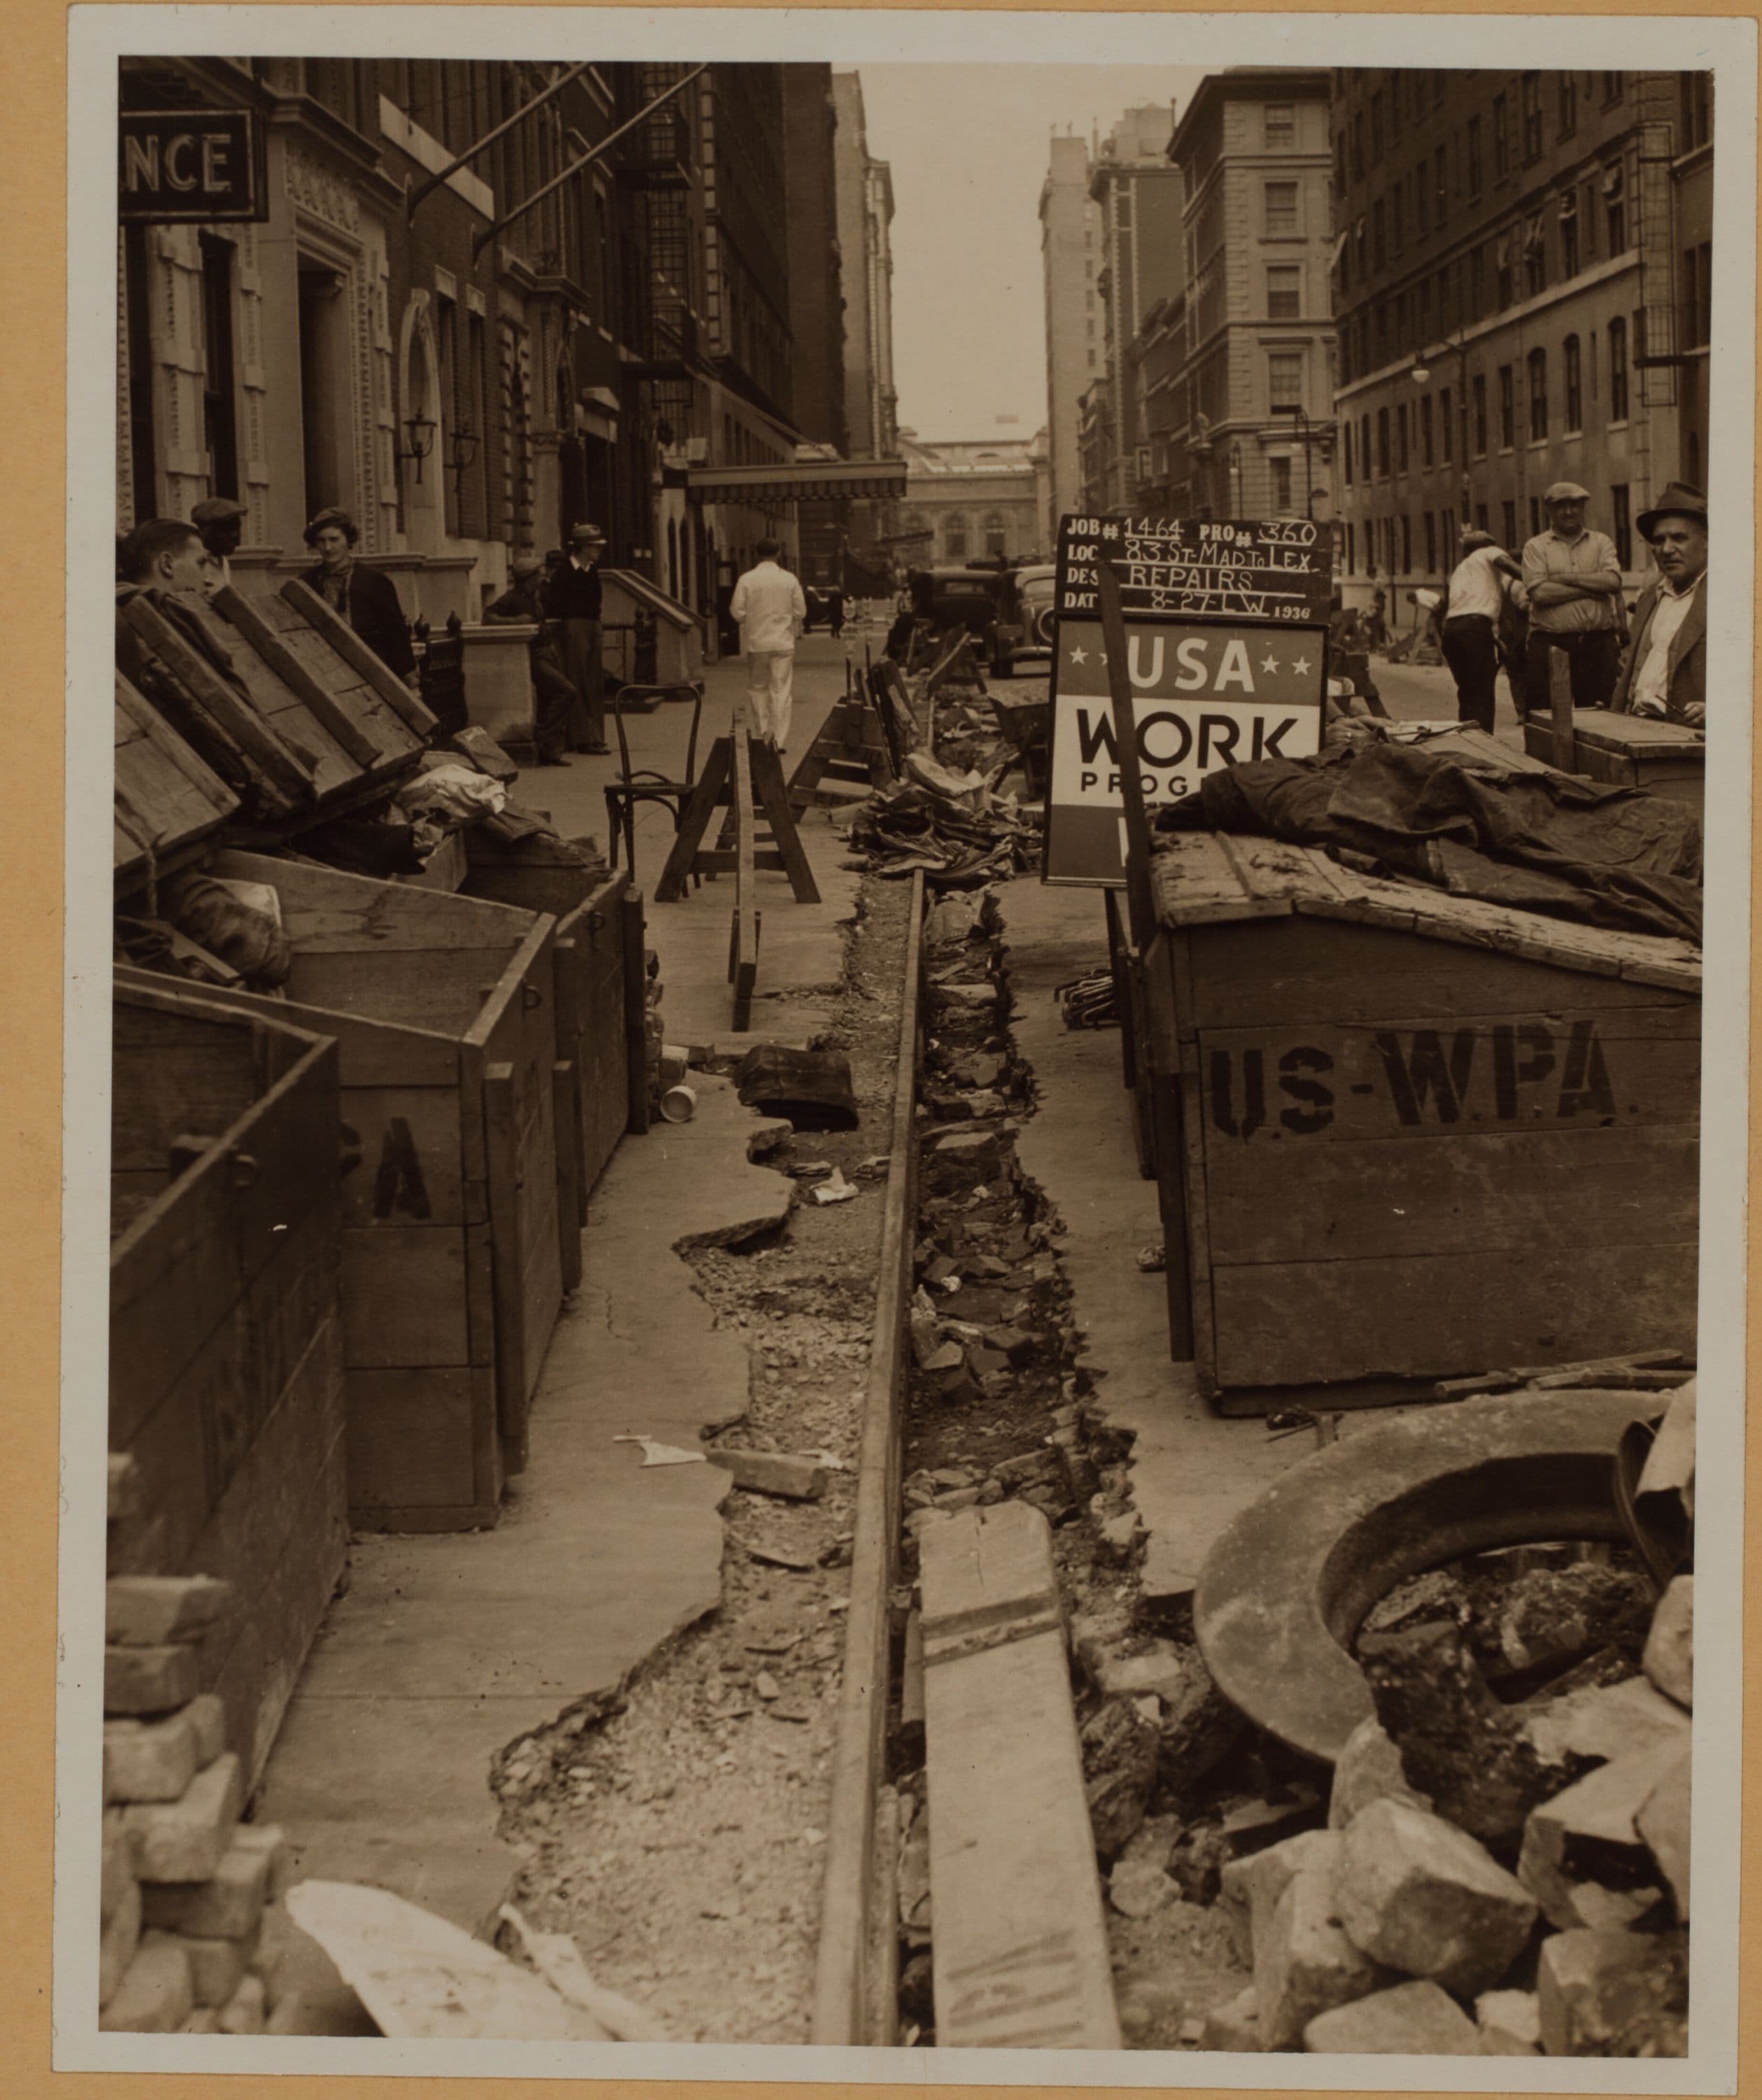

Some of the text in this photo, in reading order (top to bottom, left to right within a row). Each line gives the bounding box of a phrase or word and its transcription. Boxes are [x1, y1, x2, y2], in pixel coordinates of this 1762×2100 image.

[124, 133, 232, 192] NCE
[1124, 516, 1185, 538] 1464
[1260, 521, 1317, 543] 360
[1067, 544, 1099, 561] LOC
[1125, 539, 1164, 561] 83
[1066, 565, 1253, 592] DES REPAIRS
[1064, 591, 1099, 608] DAT
[1274, 605, 1311, 619] 1936
[1127, 635, 1255, 693] USA
[1076, 708, 1299, 769] WORK
[1081, 771, 1205, 796] PROG
